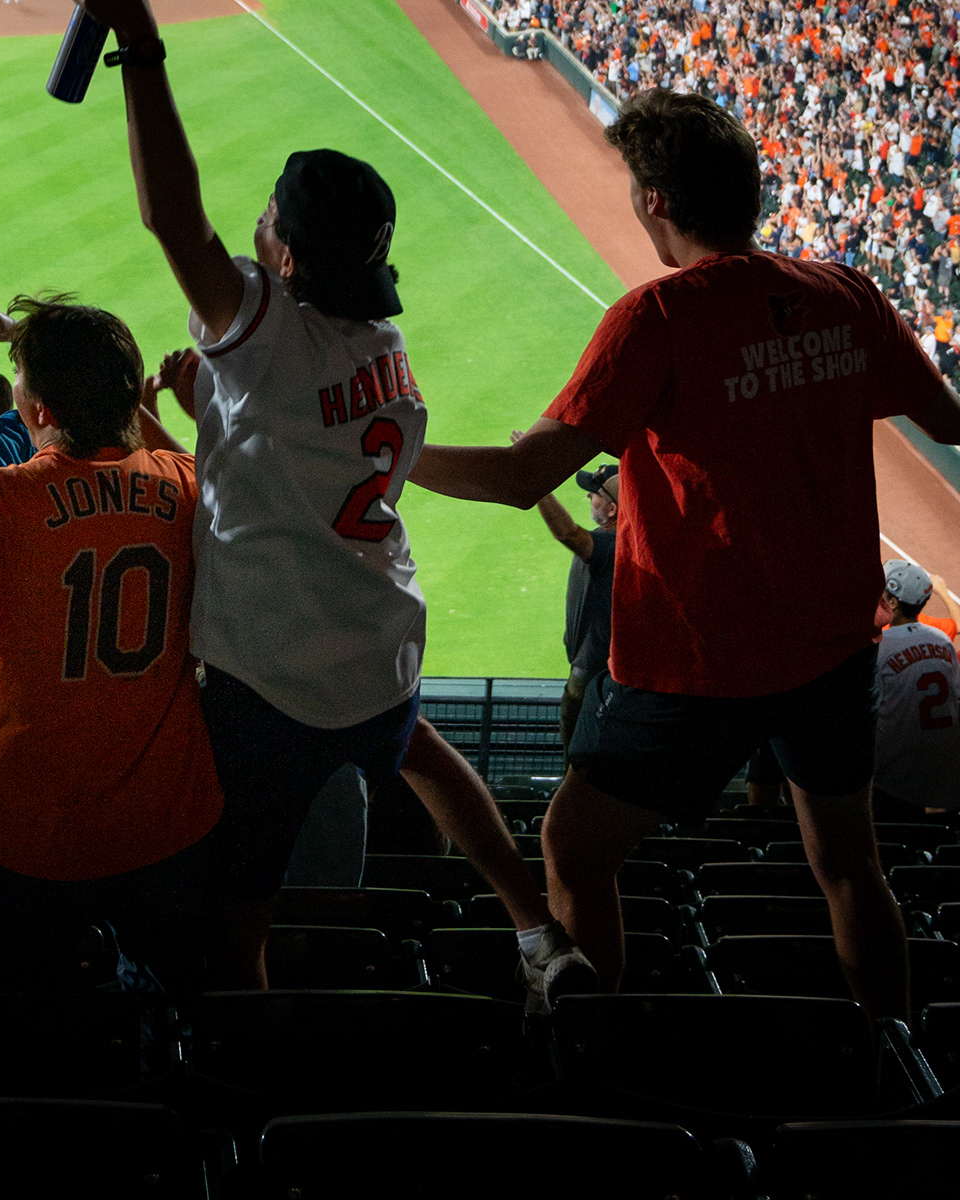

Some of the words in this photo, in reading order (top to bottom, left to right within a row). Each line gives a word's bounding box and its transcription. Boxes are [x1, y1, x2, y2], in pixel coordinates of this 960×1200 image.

[724, 372, 759, 402] TO
[765, 361, 805, 392] THE
[811, 348, 868, 382] SHOW
[741, 325, 852, 371] WELCOME
[46, 468, 179, 529] JONES
[331, 416, 403, 542] 2
[62, 543, 172, 682] 10
[916, 671, 953, 730] 2
